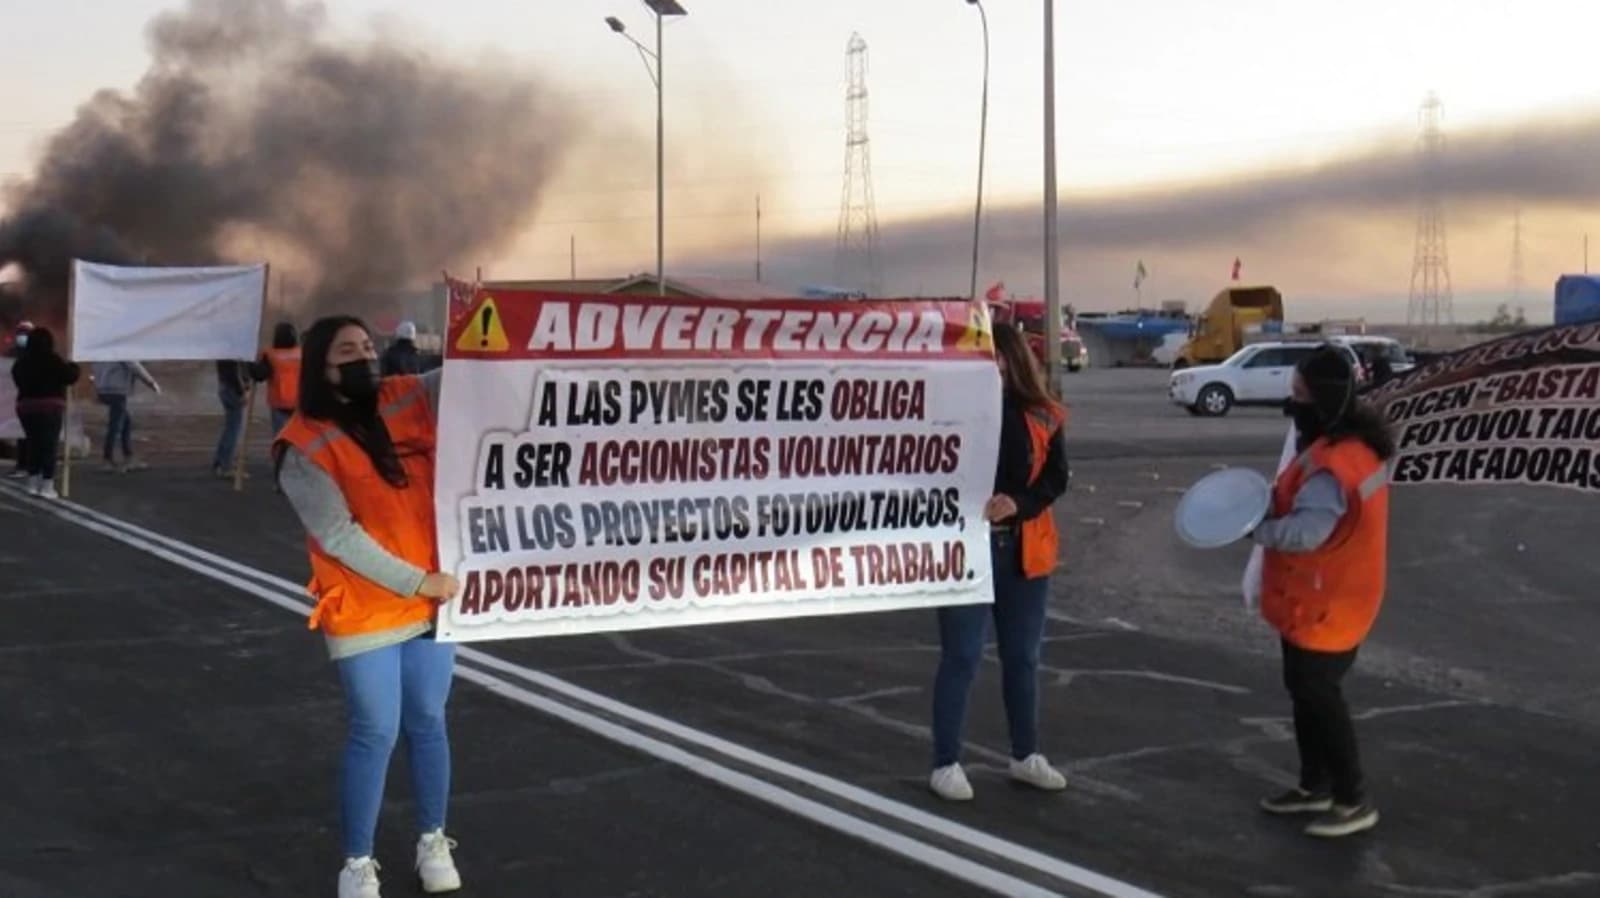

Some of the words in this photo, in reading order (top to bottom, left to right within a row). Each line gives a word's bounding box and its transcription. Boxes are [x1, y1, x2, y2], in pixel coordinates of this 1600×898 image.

[528, 301, 944, 352] ADVERTENCIA
[538, 379, 558, 426] A
[567, 380, 623, 425] LAS
[629, 381, 729, 424] PYMES
[735, 380, 771, 421] SE
[777, 379, 825, 419] LES
[831, 379, 925, 420] OBLIGA
[1388, 382, 1476, 422] DICEN
[485, 443, 505, 490] A
[514, 442, 572, 487] SER
[579, 437, 769, 485] ACCIONISTAS
[777, 434, 961, 478] VOLUNTARIOS
[470, 508, 511, 553] EN
[516, 503, 576, 552] LOS
[582, 497, 750, 546] PROYECTOS
[757, 487, 966, 538] FOTOVOLTAICOS,
[459, 560, 640, 616] APORTANDO
[648, 556, 685, 600] SU
[693, 550, 807, 597] CAPITAL
[812, 546, 846, 590] DE
[850, 541, 976, 585] TRABAJO.
